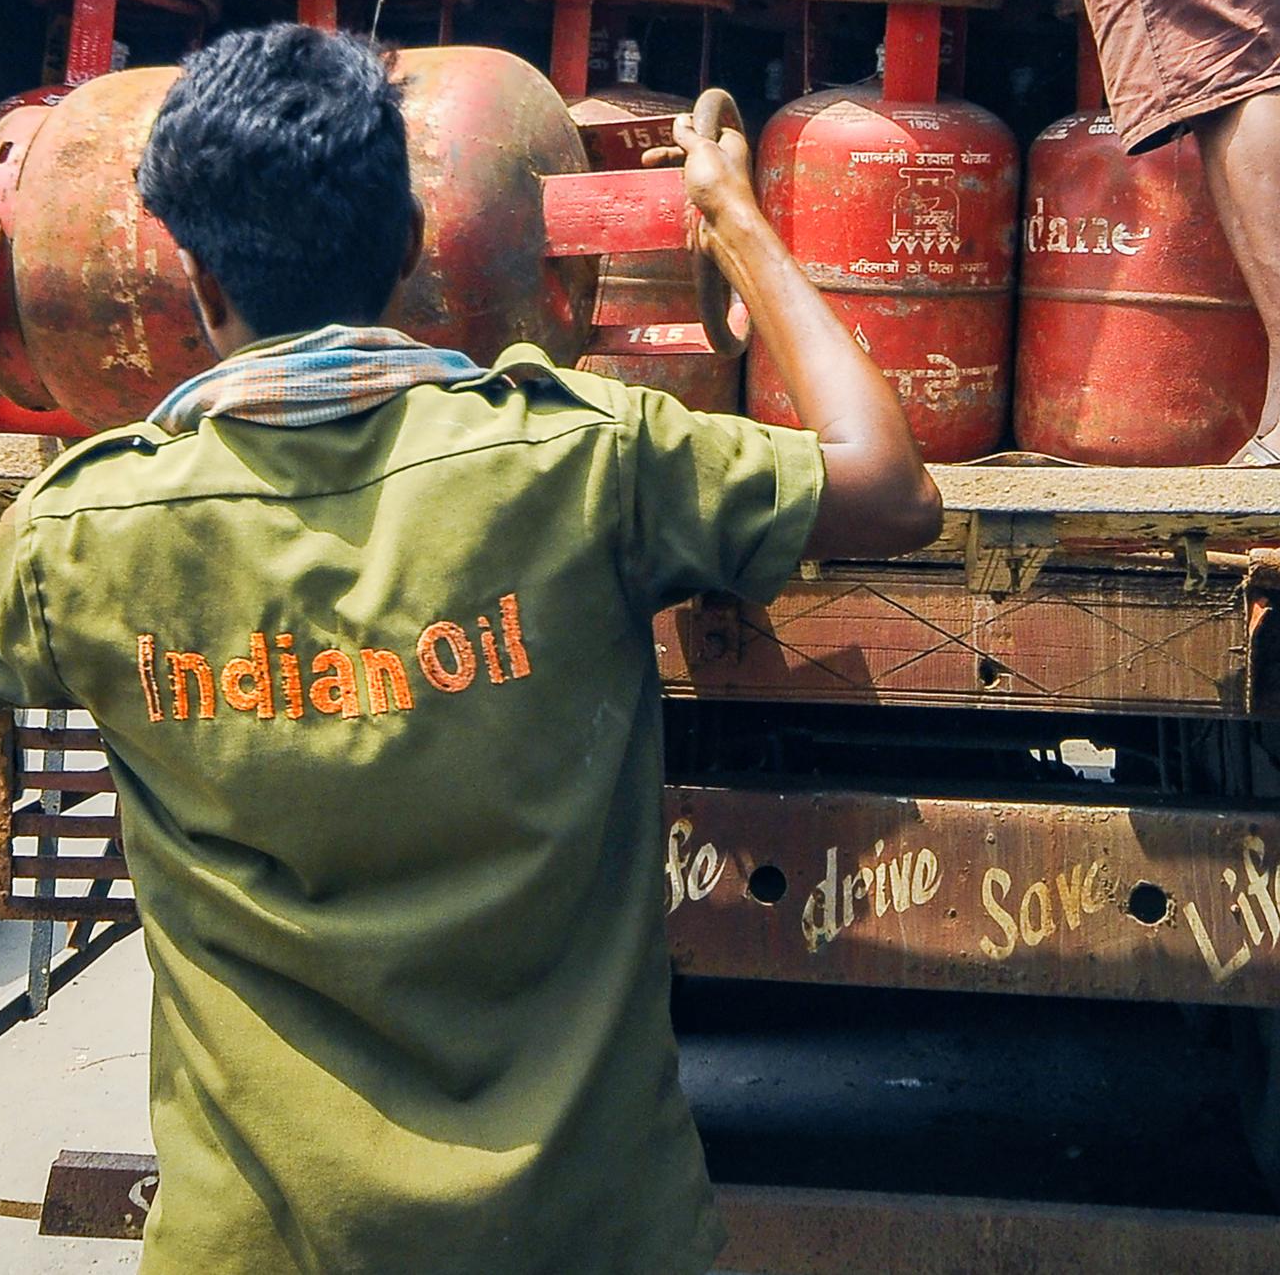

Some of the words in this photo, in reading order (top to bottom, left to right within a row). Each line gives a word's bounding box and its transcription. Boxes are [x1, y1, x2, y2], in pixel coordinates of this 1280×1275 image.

[907, 119, 940, 131] 1906
[1095, 116, 1112, 124] NE
[1088, 124, 1119, 135] GRO
[627, 327, 685, 344] 15.5
[137, 631, 415, 723] Indian
[417, 592, 532, 693] Oil
[664, 817, 728, 915] fe
[801, 838, 945, 954] drive
